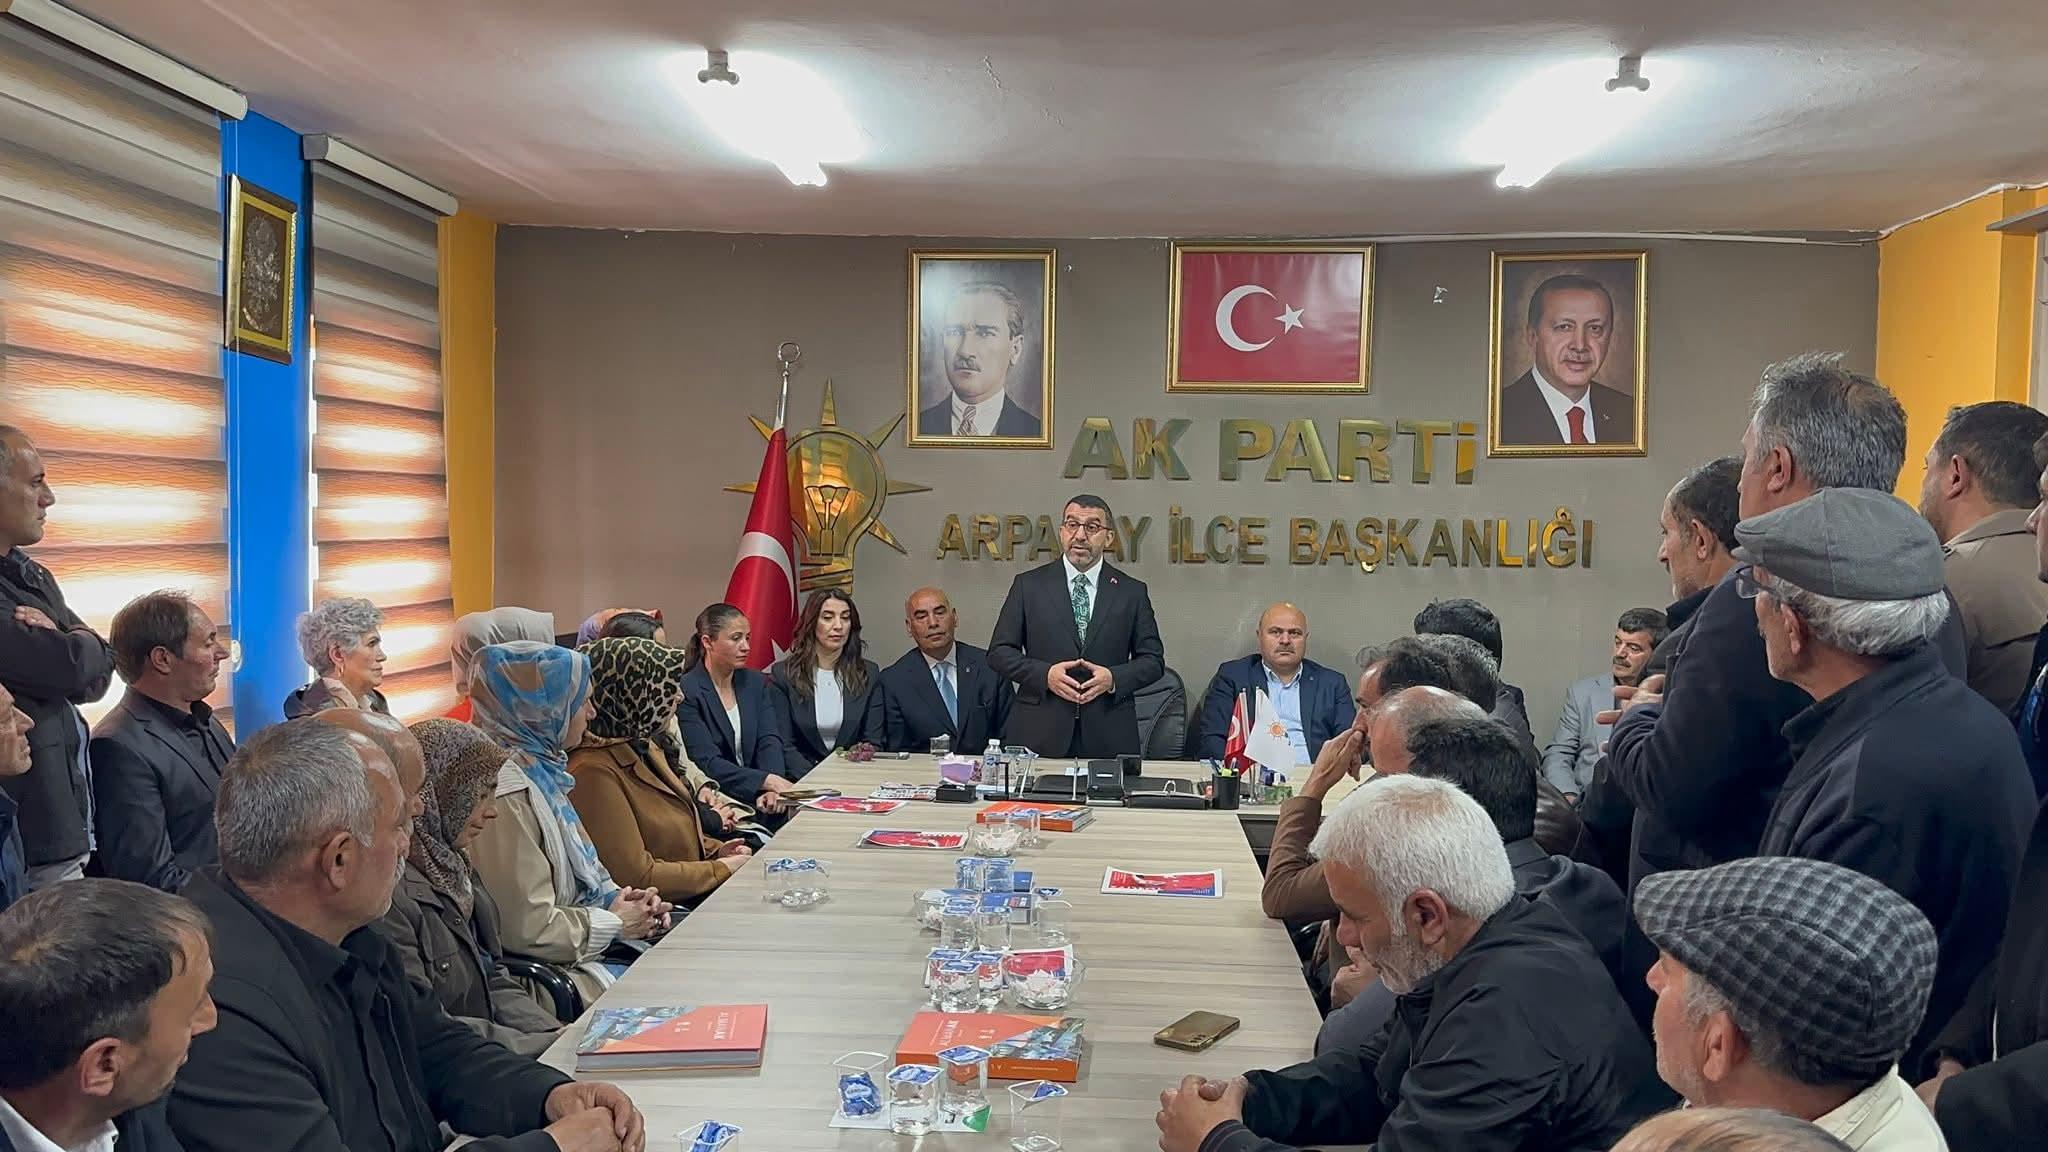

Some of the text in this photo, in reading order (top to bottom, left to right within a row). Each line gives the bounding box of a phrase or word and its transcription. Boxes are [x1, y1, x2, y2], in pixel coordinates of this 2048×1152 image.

[1062, 416, 1194, 482] AK
[936, 513, 1151, 563] ARPAAY
[1290, 506, 1594, 574] BAŞKANLIĞI
